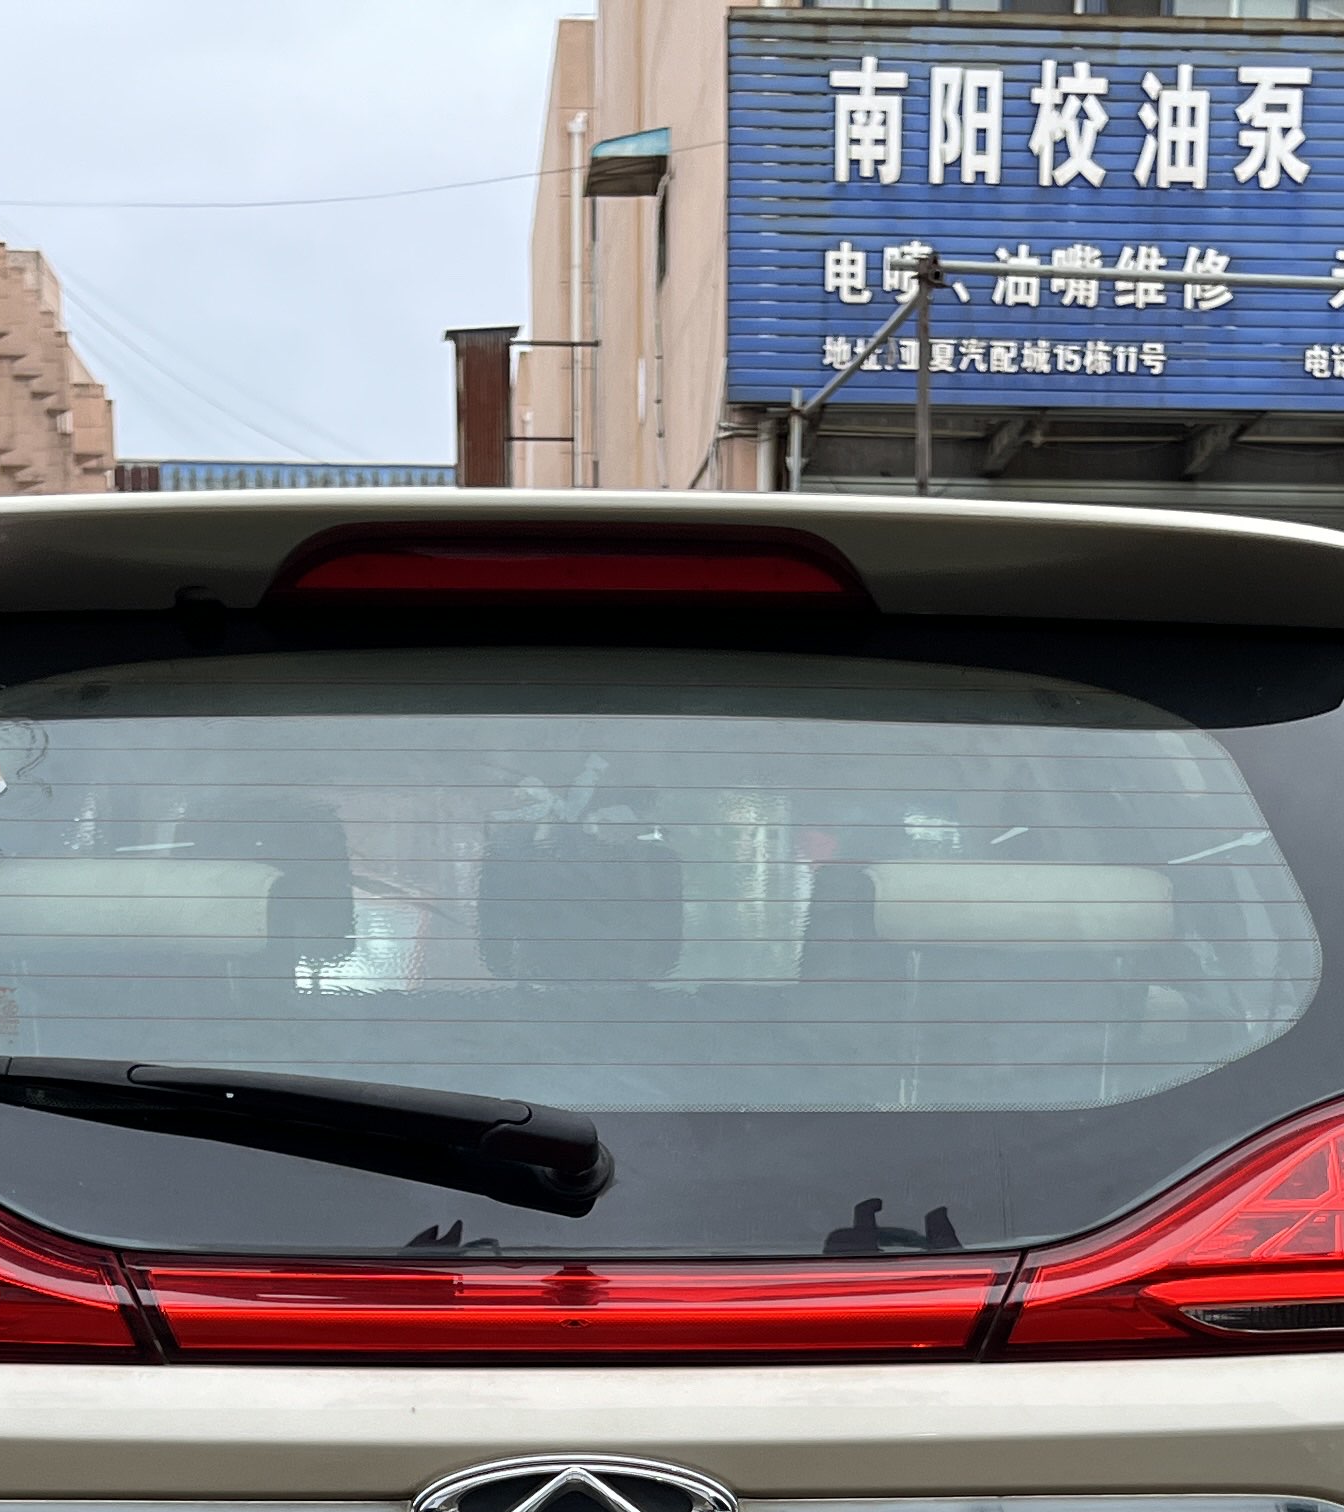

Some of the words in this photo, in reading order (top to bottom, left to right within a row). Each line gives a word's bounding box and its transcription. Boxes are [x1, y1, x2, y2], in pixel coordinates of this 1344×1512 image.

[828, 56, 1312, 190] 南阳校油泵
